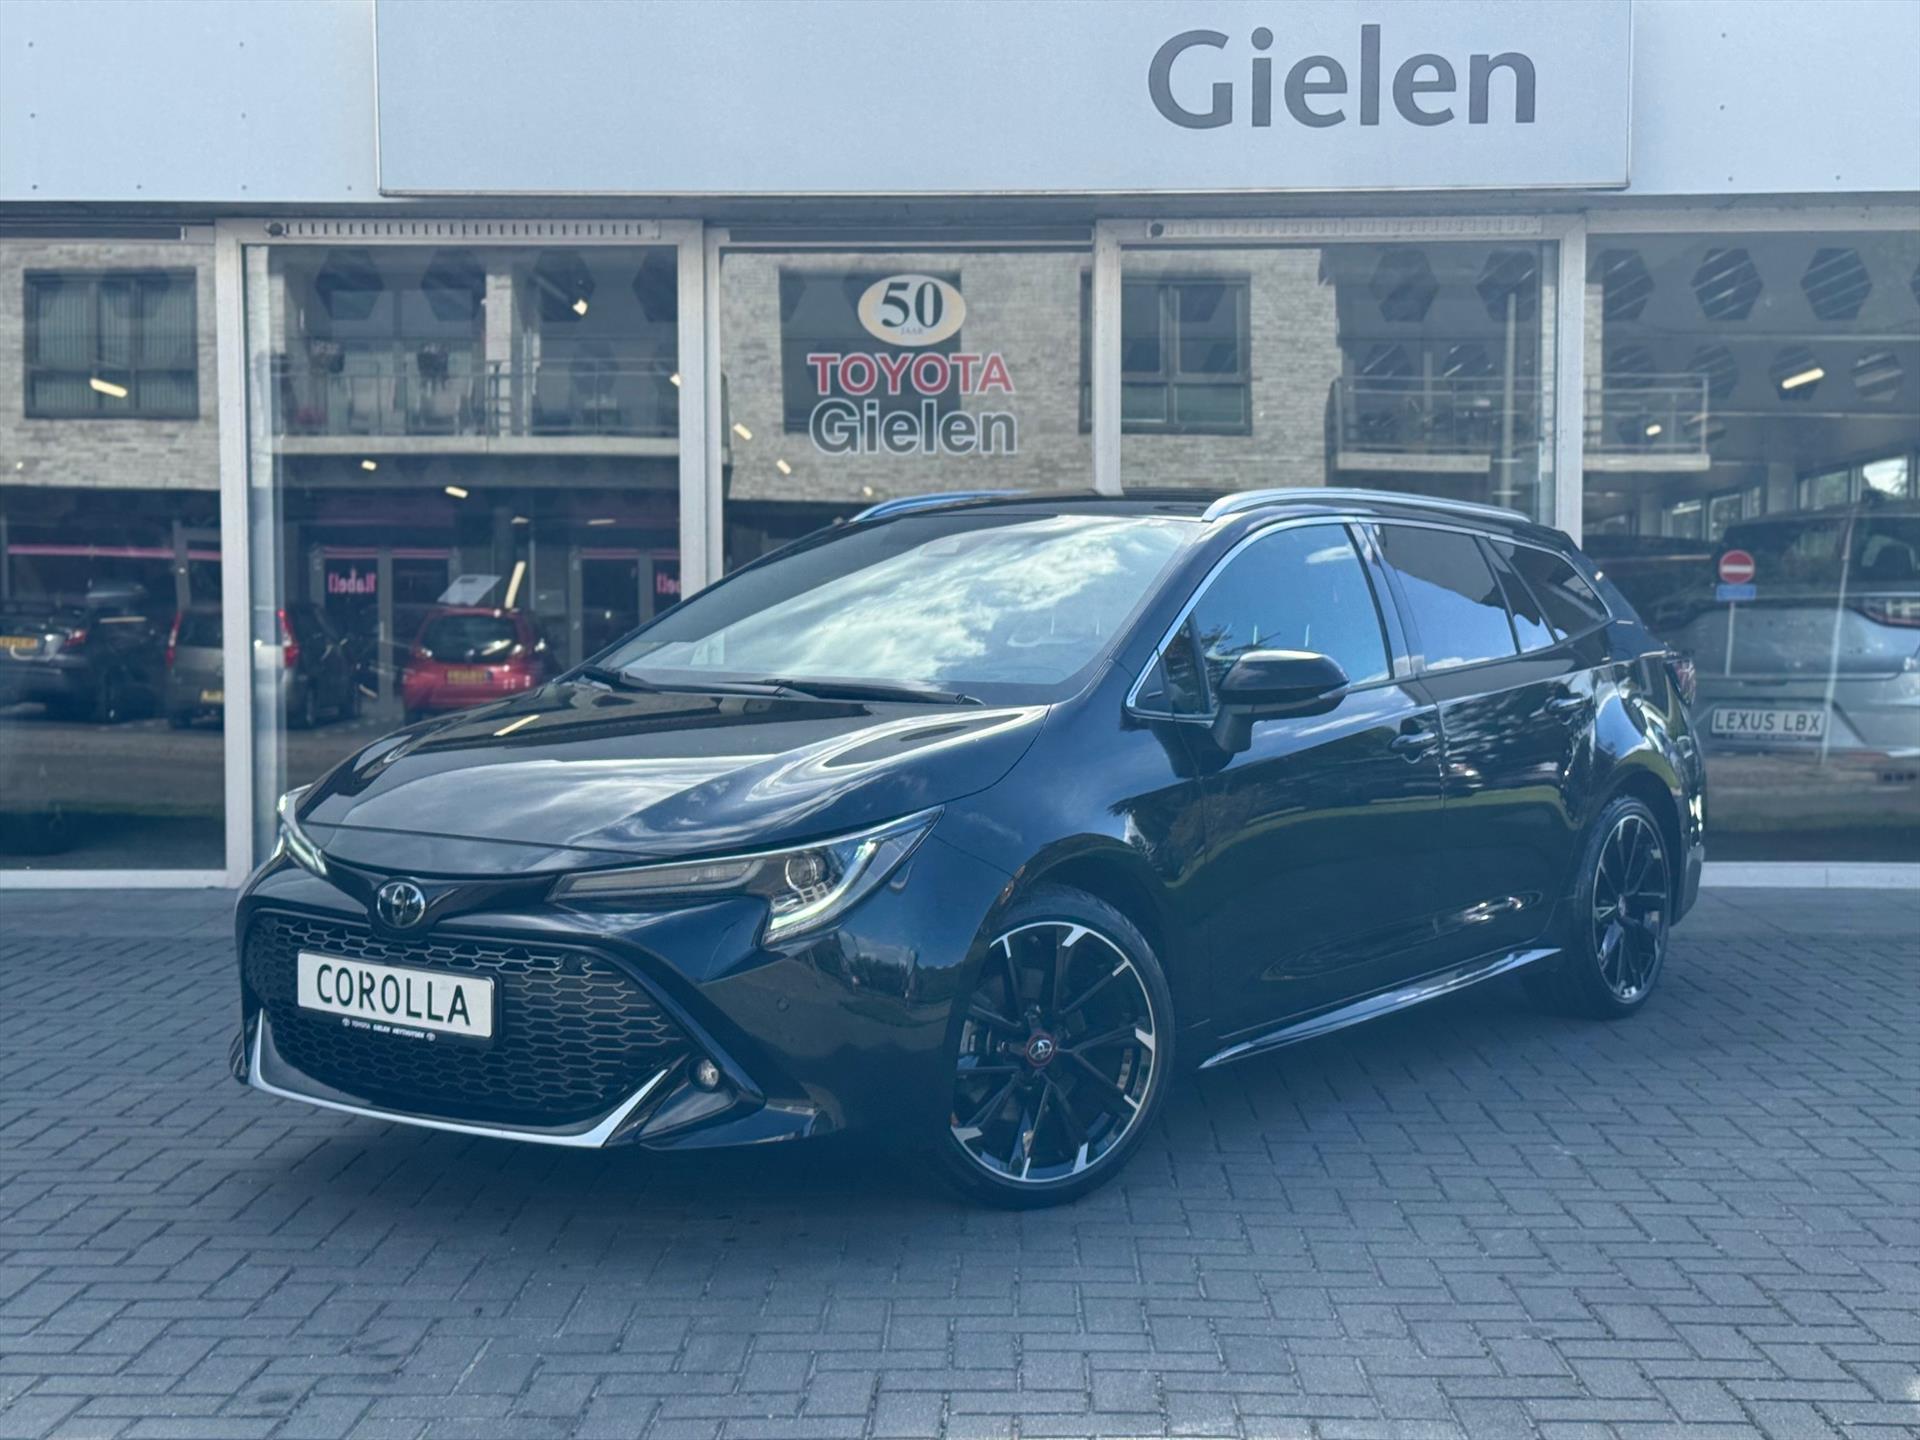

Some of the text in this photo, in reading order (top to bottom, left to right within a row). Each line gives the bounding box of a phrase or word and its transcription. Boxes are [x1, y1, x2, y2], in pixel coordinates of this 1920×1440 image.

[1148, 23, 1536, 130] Gielen
[880, 281, 943, 328] 50
[807, 353, 1016, 395] TOYOTA
[809, 398, 1018, 456] Gielen
[1714, 711, 1820, 733] LEXUS LBX
[316, 963, 471, 1026] COROLLA
